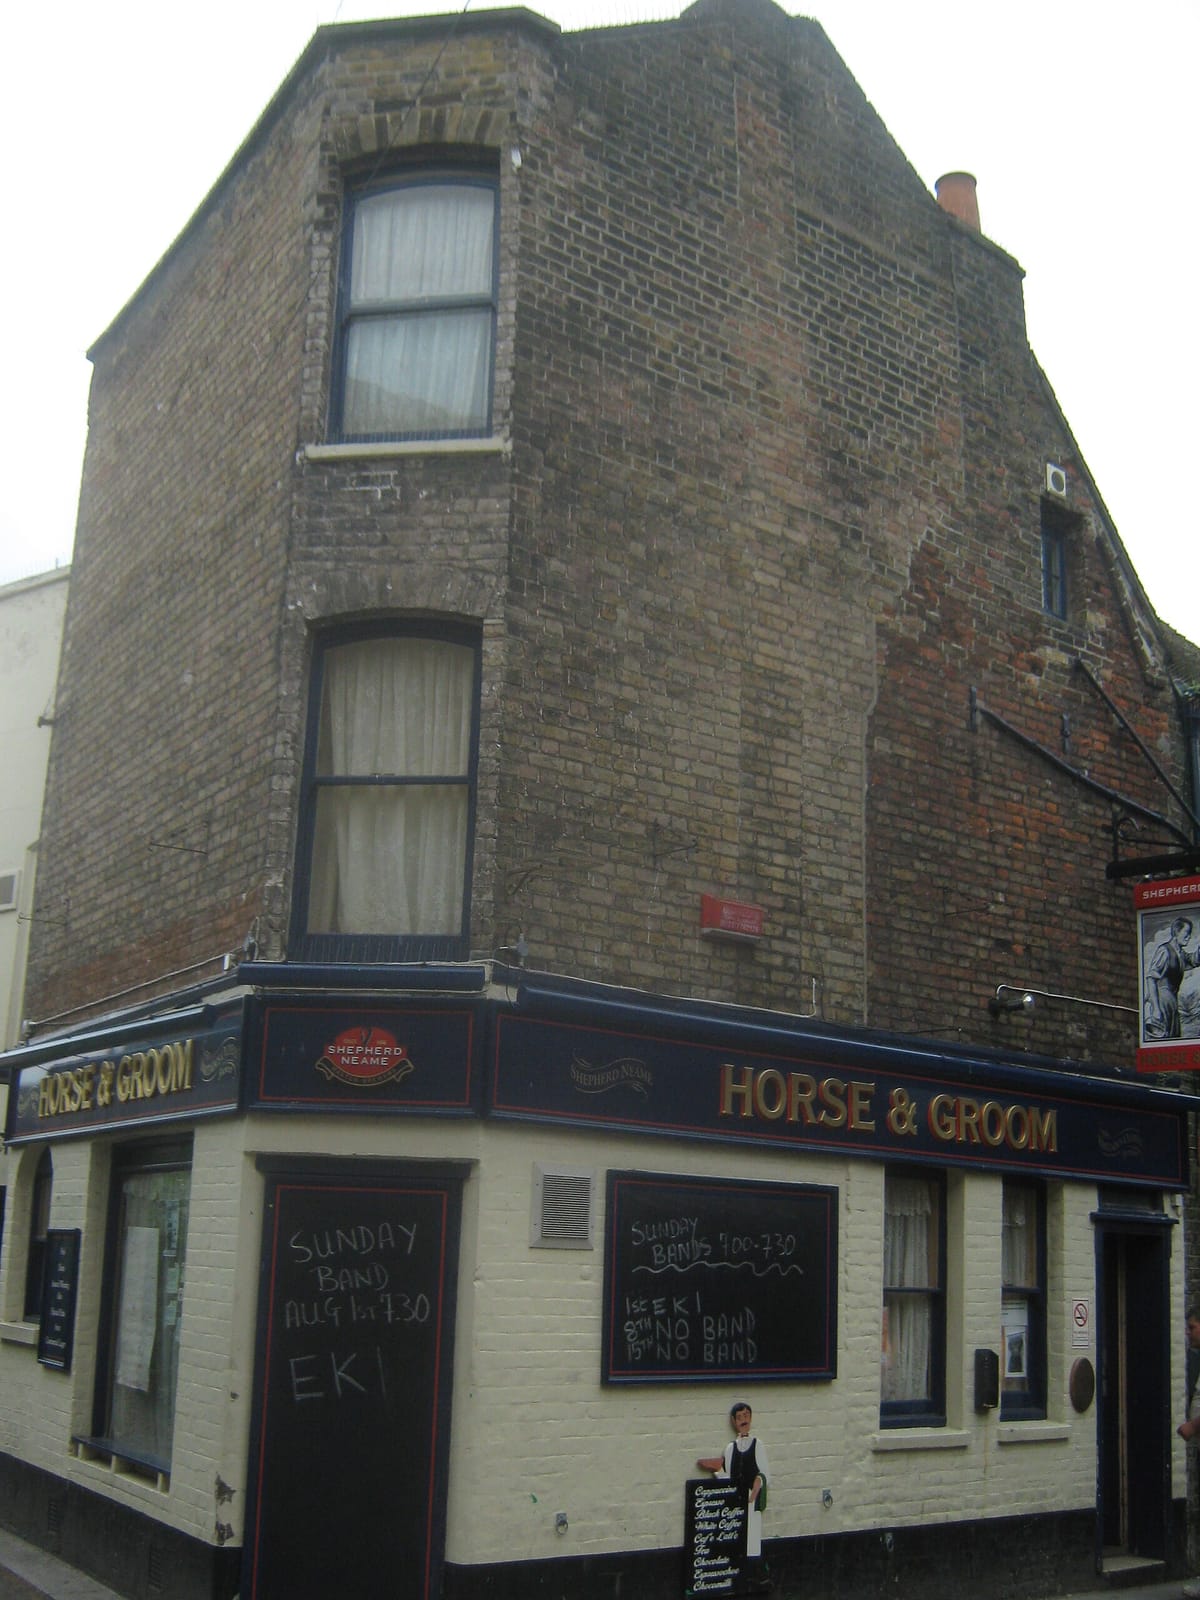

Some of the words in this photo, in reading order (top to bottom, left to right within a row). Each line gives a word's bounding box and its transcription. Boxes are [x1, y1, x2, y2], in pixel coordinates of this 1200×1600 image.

[328, 1045, 402, 1056] SHEPHERD
[341, 1056, 389, 1066] NEAME
[38, 1065, 96, 1118] HORSE
[97, 1060, 115, 1107] &
[116, 1038, 193, 1102] GROOM
[719, 1063, 876, 1132] HORSE
[886, 1086, 918, 1136] &
[927, 1093, 1059, 1154] GROOM
[289, 1222, 417, 1263] SUNDAY
[631, 1217, 698, 1246] SUNDAY
[653, 1238, 711, 1265] BANDS
[309, 1262, 389, 1292] BAND
[286, 1297, 342, 1329] AUG
[656, 1316, 690, 1341] NO
[703, 1307, 755, 1340] BAND
[656, 1341, 690, 1361] NO
[703, 1339, 757, 1363] BAND
[718, 1519, 742, 1530] Coffee
[722, 1507, 744, 1518] Coffee
